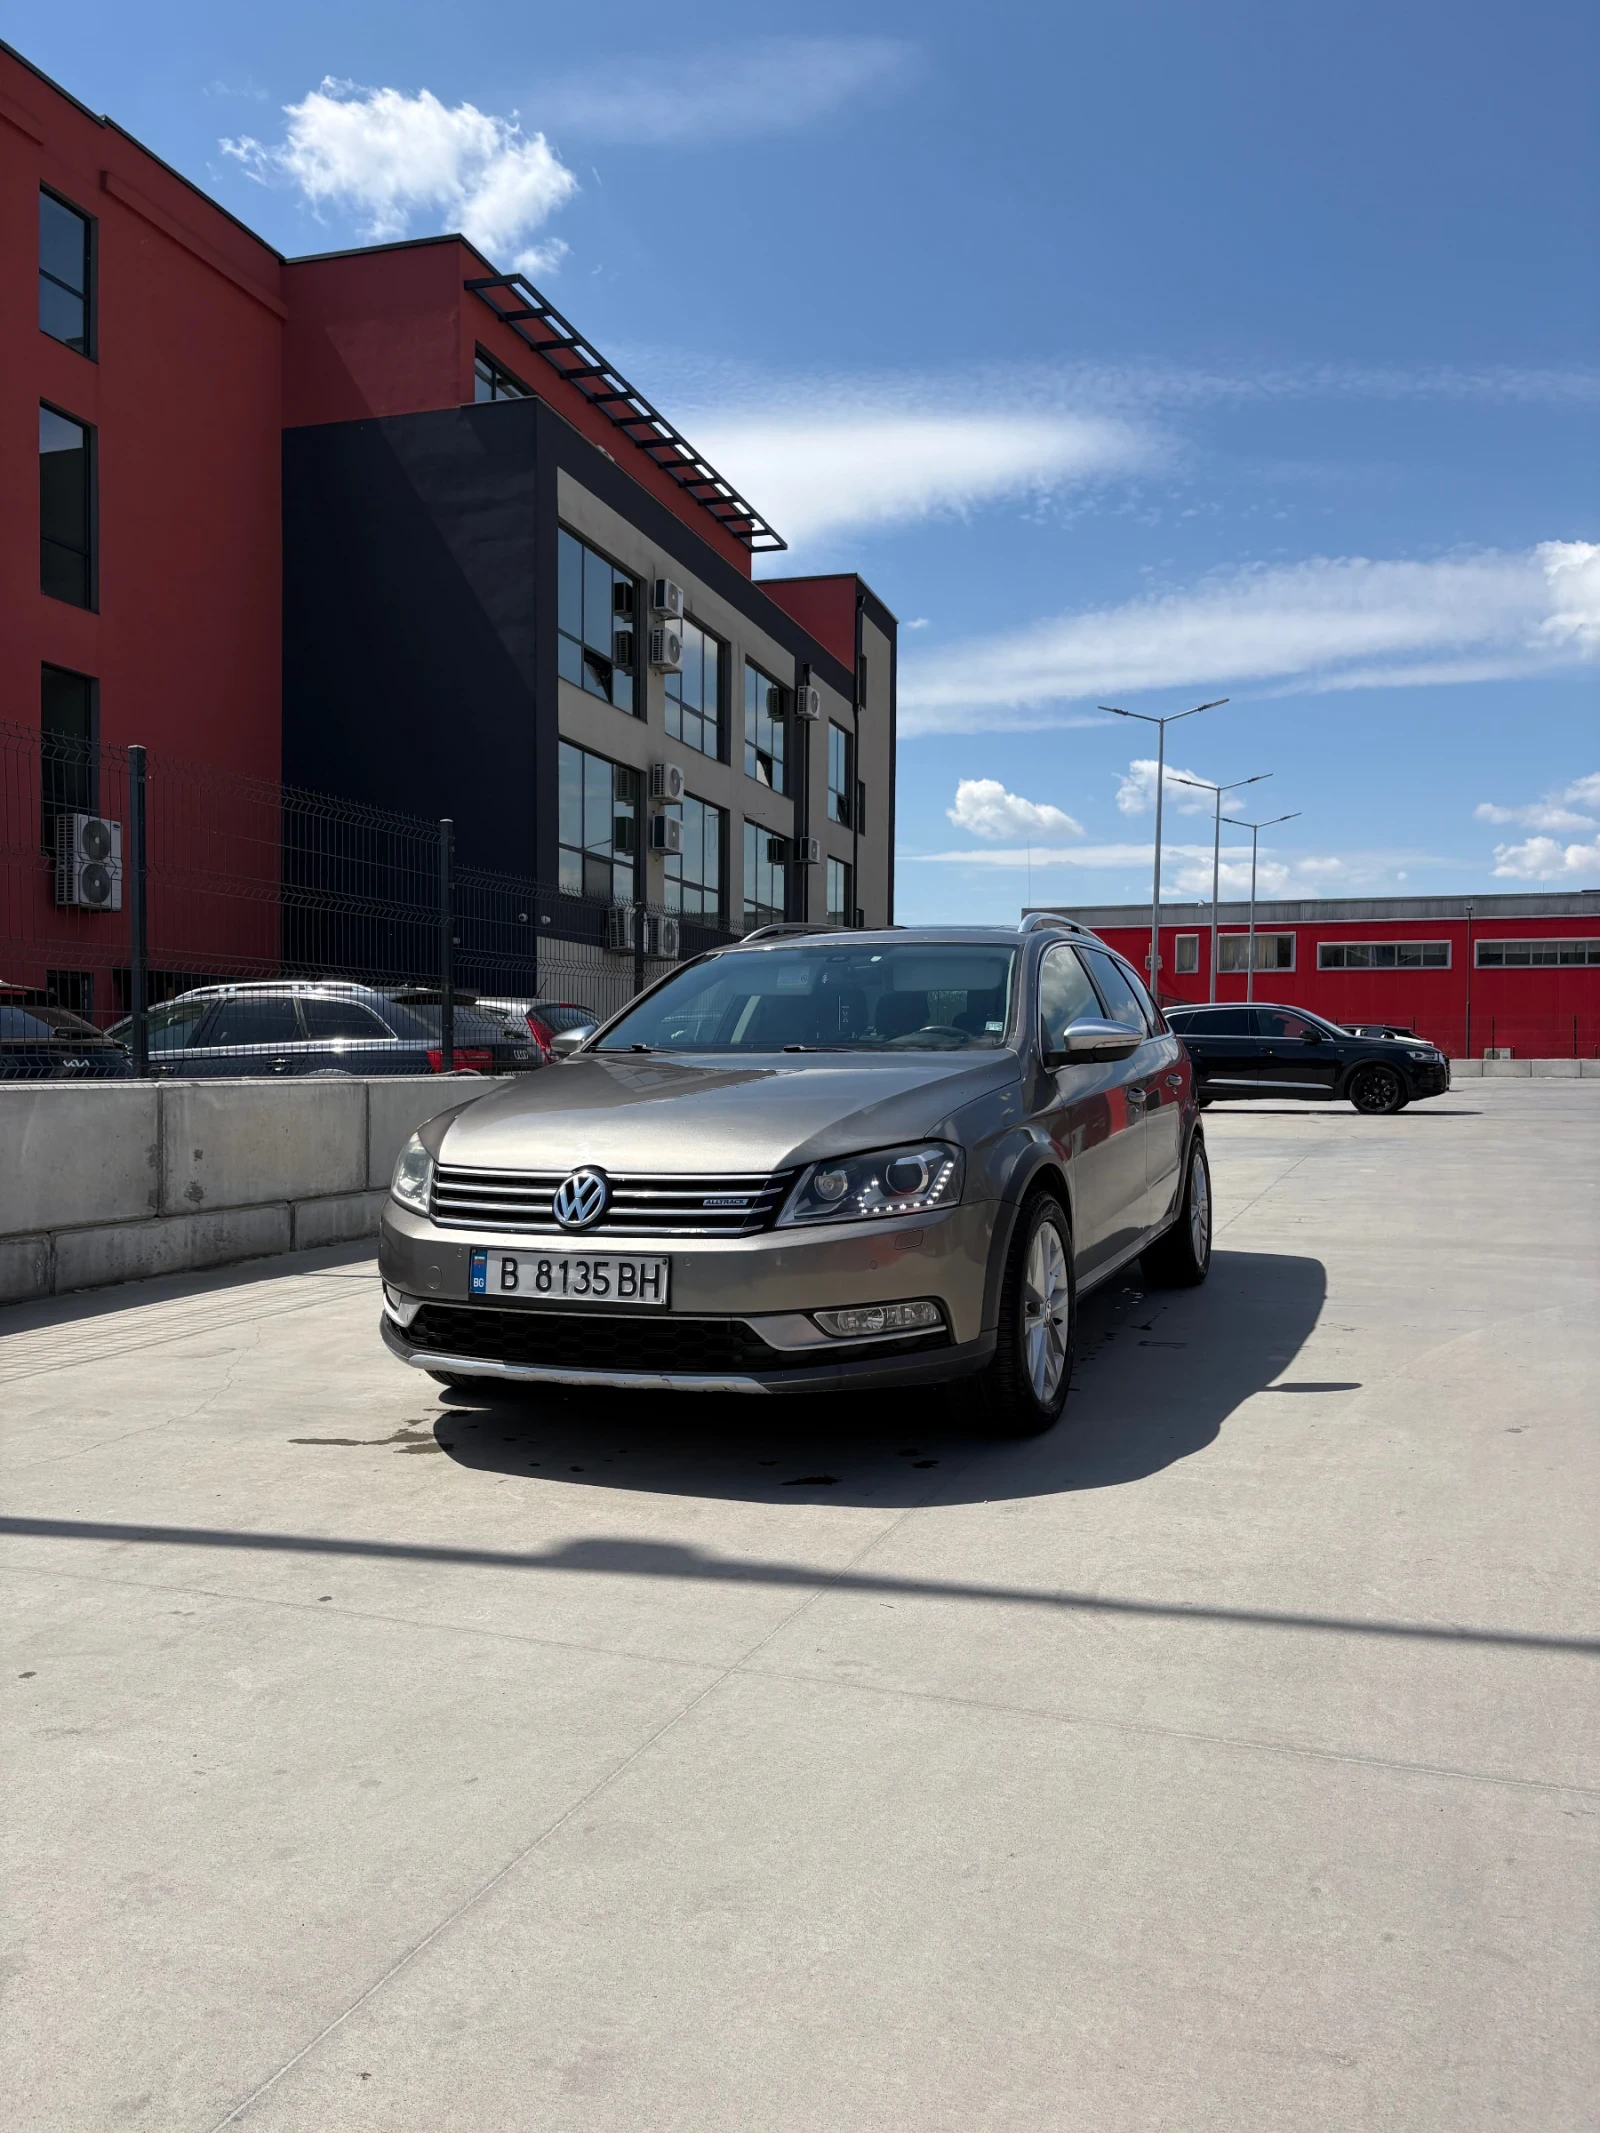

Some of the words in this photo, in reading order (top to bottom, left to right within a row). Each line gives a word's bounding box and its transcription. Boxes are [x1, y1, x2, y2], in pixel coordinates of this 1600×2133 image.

[555, 1173, 605, 1226] VW
[473, 1277, 485, 1288] BG
[501, 1257, 519, 1291] B
[535, 1259, 610, 1296] 8135
[617, 1262, 661, 1298] BH
